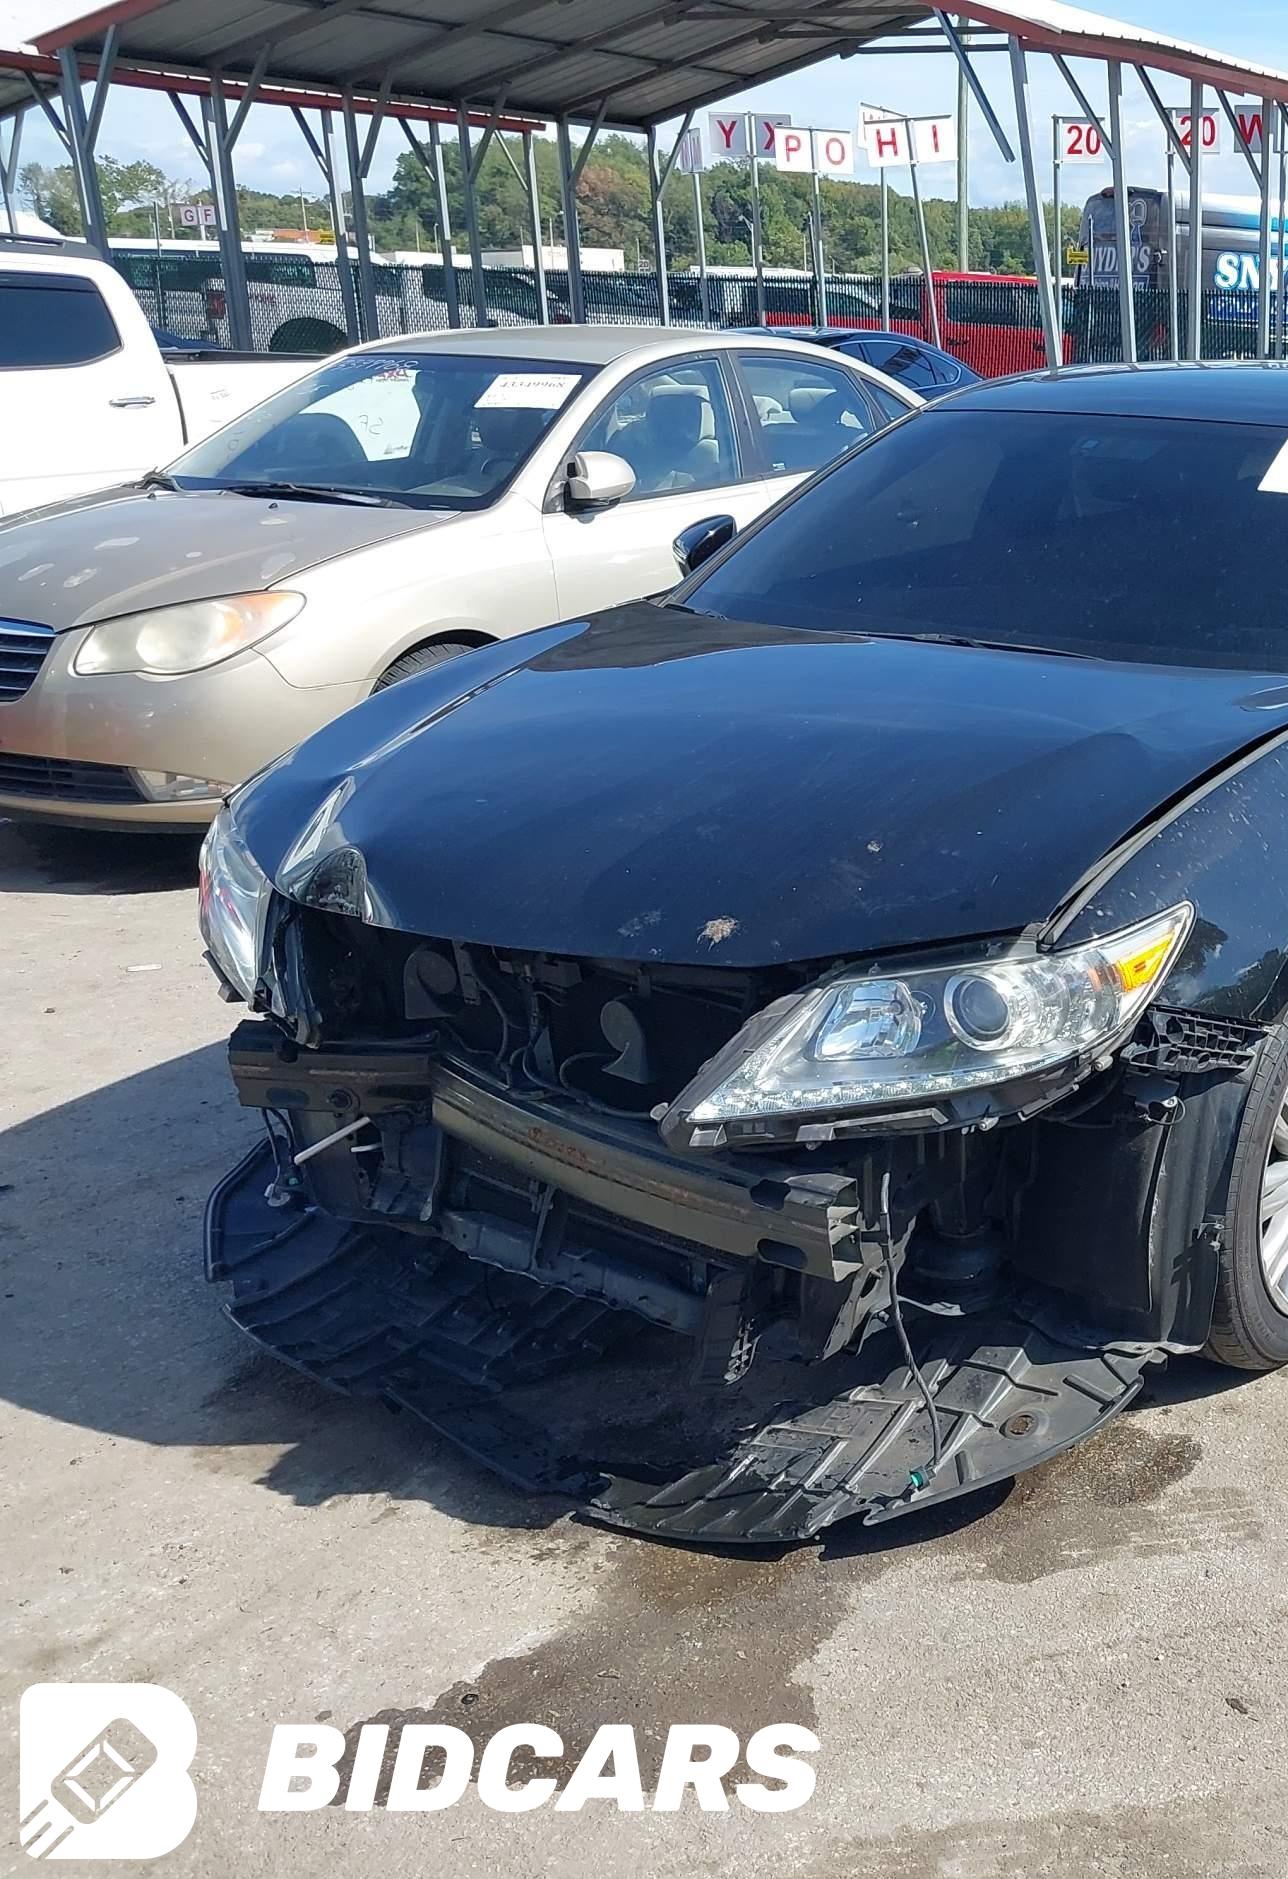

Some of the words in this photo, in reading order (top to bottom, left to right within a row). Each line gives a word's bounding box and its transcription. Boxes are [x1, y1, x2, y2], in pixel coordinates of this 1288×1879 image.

[717, 119, 737, 149] Y
[876, 127, 898, 157] H
[932, 124, 940, 153] I
[1067, 125, 1101, 155] 20
[1180, 115, 1216, 146] 20
[785, 134, 802, 162] P
[184, 206, 194, 223] G
[204, 206, 212, 222] F
